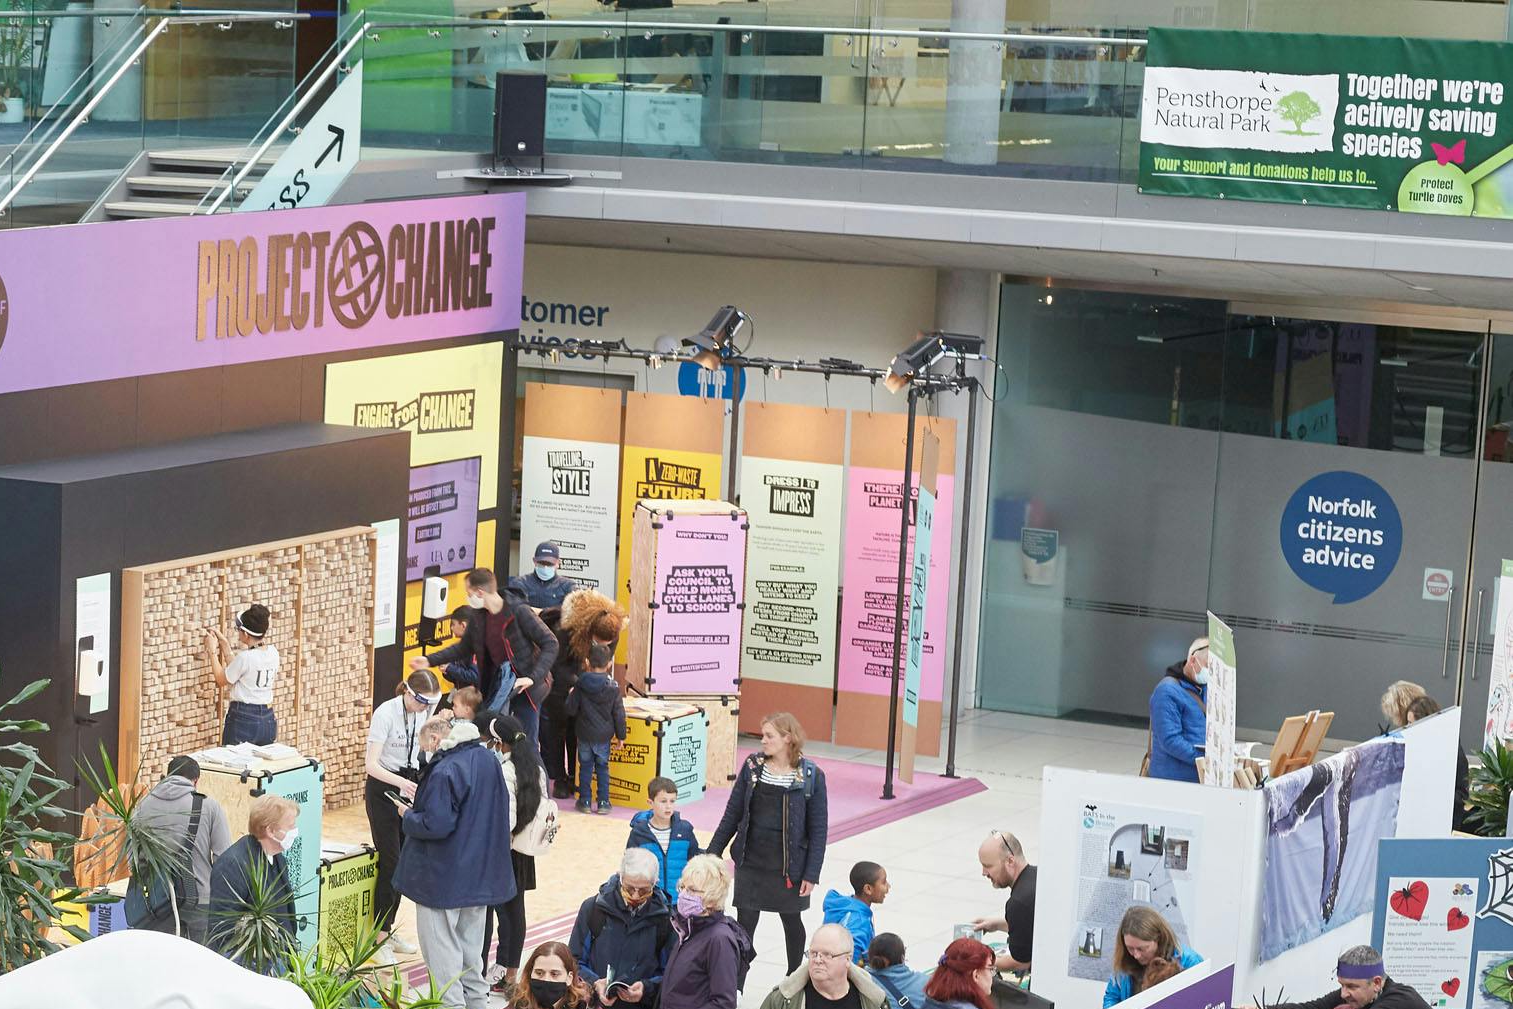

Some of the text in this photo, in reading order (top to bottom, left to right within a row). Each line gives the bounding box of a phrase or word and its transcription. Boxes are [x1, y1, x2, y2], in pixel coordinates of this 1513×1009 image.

[1156, 87, 1273, 114] Pensthorpe
[1347, 73, 1504, 105] Together we're
[1154, 109, 1271, 133] Natural Park
[1344, 102, 1497, 137] actively saving
[1342, 131, 1423, 160] species
[1154, 157, 1181, 173] Your
[1183, 158, 1227, 176] support
[1229, 161, 1251, 176] and
[1253, 161, 1308, 181] donations
[1311, 164, 1335, 184] help
[1338, 167, 1353, 183] us
[1420, 178, 1454, 192] Protect
[1408, 190, 1463, 205] Turtle Doves
[196, 217, 496, 342] PROJECT CHANGE
[357, 393, 474, 432] ENGAGE FOR CHANGE
[553, 469, 589, 494] STYLE
[647, 460, 699, 487] A ZERO-WASTE
[766, 476, 816, 489] DRESS TO
[637, 483, 704, 499] FUTURE
[865, 484, 900, 494] THERE
[772, 489, 811, 514] IMPRESS
[870, 496, 902, 508] PLANET
[1308, 495, 1376, 519] Norfolk
[1298, 519, 1384, 546] citizens
[1302, 545, 1375, 570] advice
[668, 577, 731, 586] COUNCIL TO
[674, 568, 726, 577] ASK YOUR
[664, 594, 734, 603] CYCLE LANES
[667, 586, 731, 594] BUILD MORE
[670, 603, 728, 612] TO SCHOOL
[329, 862, 375, 890] PROJECT CHANGE
